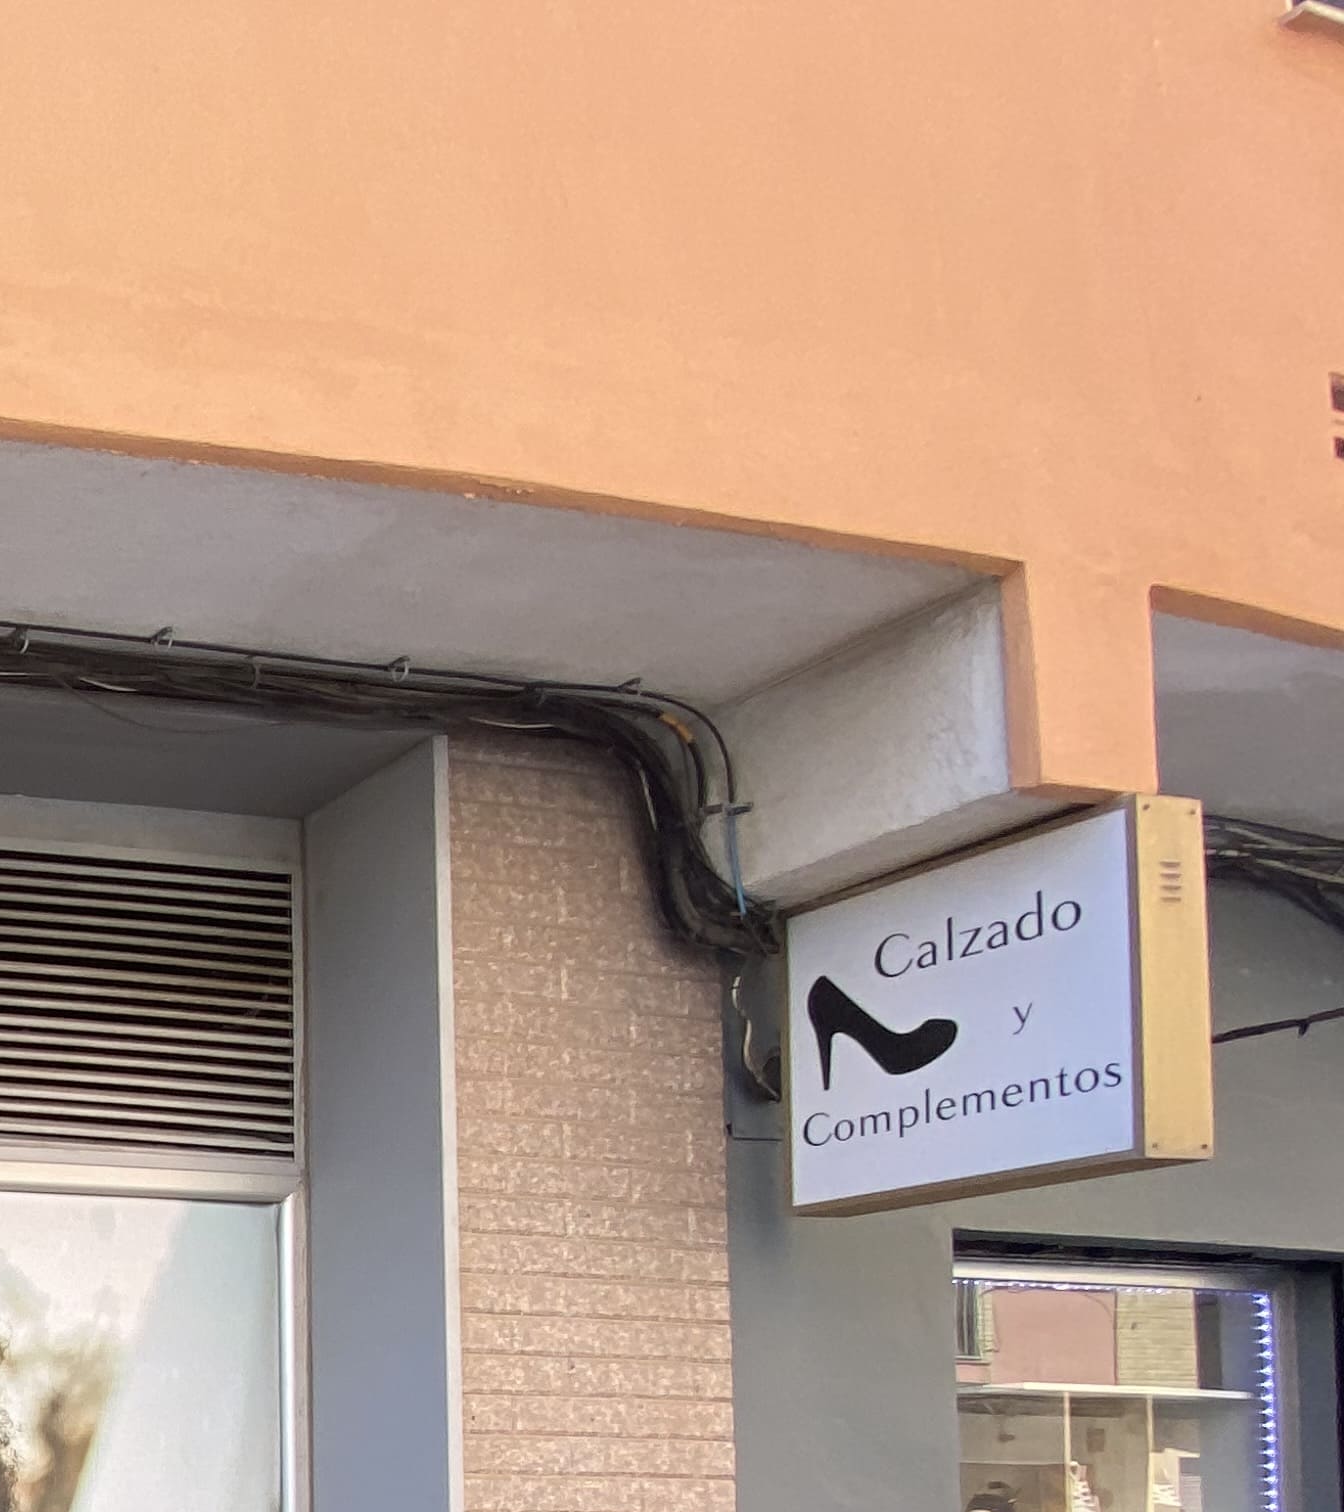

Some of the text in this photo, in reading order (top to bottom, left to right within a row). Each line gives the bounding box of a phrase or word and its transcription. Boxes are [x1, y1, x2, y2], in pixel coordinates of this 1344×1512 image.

[874, 889, 1082, 978] Calzado
[1012, 1002, 1033, 1035] y
[802, 1062, 1123, 1147] Complementos
